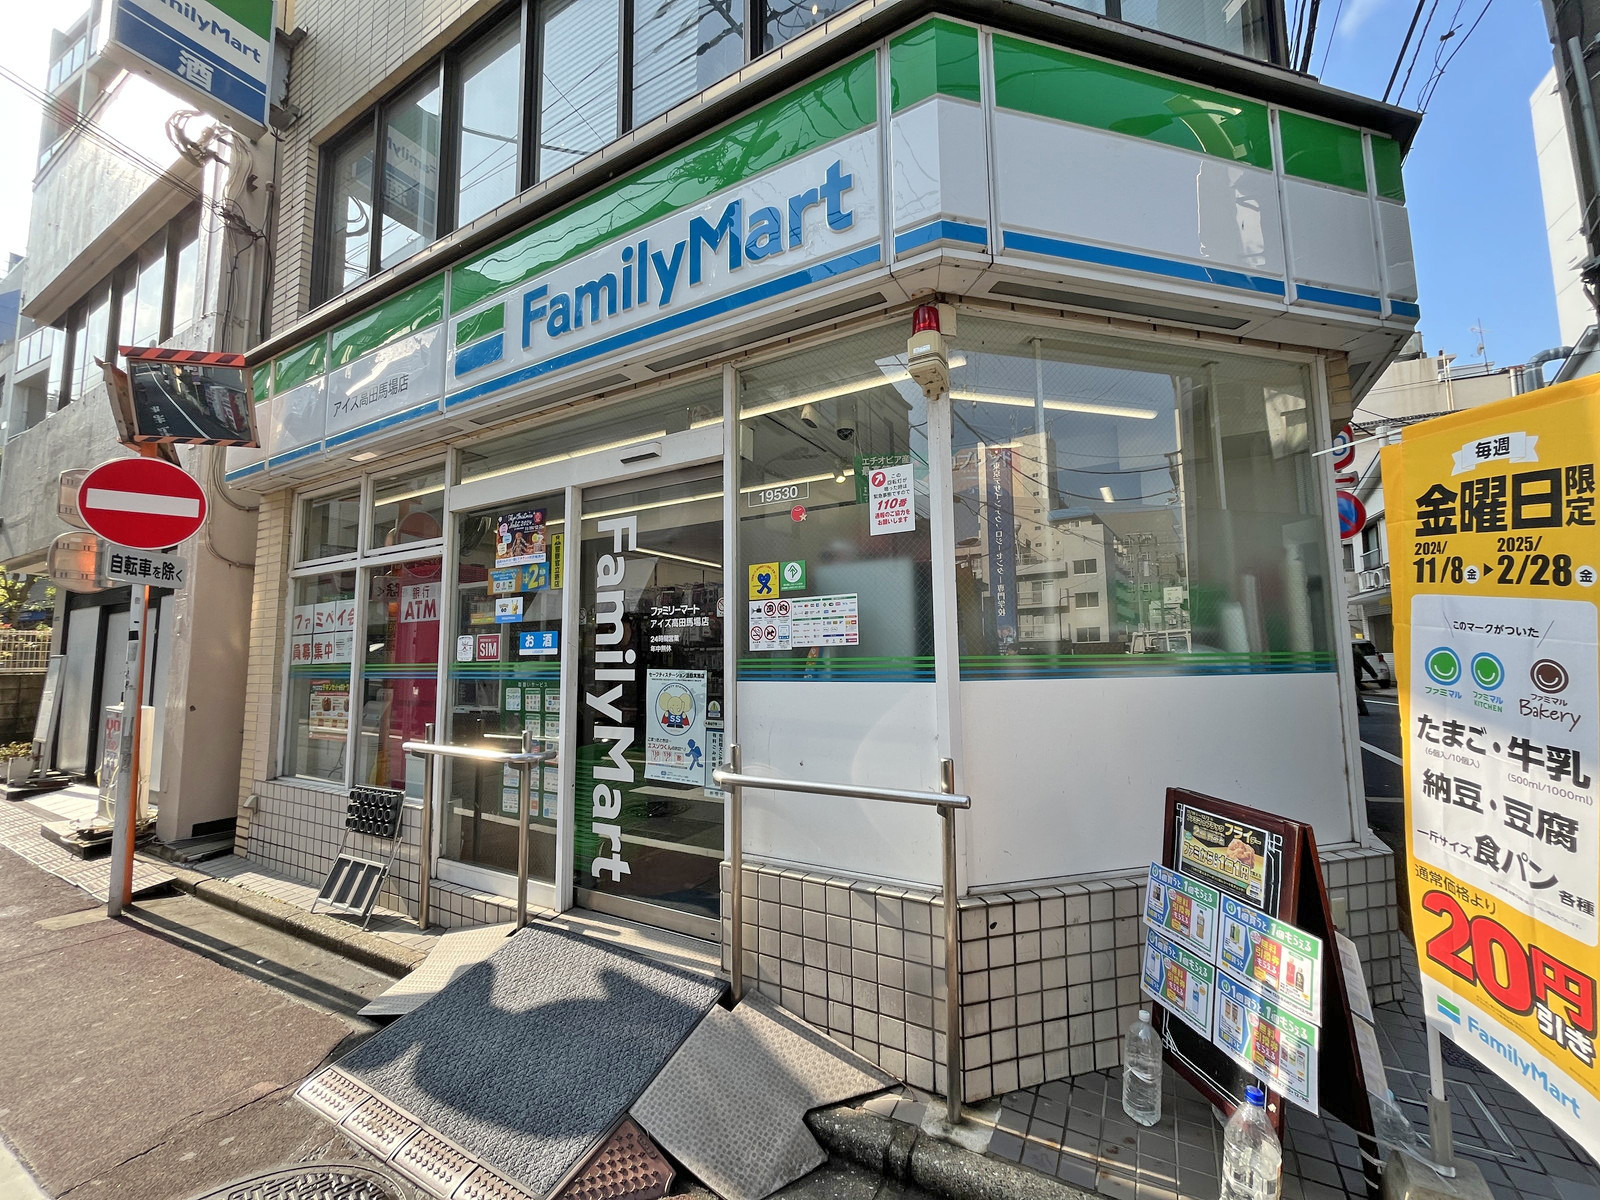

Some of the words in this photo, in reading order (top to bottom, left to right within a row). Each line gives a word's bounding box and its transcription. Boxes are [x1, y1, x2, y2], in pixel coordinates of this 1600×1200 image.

[177, 50, 214, 92] 酒
[521, 159, 856, 351] FamilyMart
[1475, 436, 1510, 459] 毎週
[758, 486, 799, 503] 19530
[877, 498, 908, 511] 110番
[1415, 467, 1563, 537] 金曜日
[1565, 463, 1596, 527] 限定
[877, 516, 909, 526] お願いします
[1414, 541, 1448, 556] 2024/
[1497, 536, 1543, 553] 2025/
[110, 553, 184, 583] 自転車を除く
[1413, 556, 1464, 584] 11/8
[1497, 554, 1572, 587] 2/28
[404, 598, 437, 621] ATM
[650, 604, 701, 617] ファミリーマート
[524, 633, 553, 648] お酒
[1453, 620, 1540, 638] このマークがついた
[292, 641, 333, 661] 員募集中
[480, 642, 497, 657] SIM
[586, 515, 638, 883] FamilyMart
[1424, 686, 1462, 699] ファミマル
[1472, 691, 1504, 705] ファミマル
[1530, 693, 1568, 707] ファミマル
[1474, 700, 1503, 713] KITCHEN
[1519, 698, 1581, 733] Bakery
[669, 715, 681, 723] SS
[1416, 714, 1592, 790] たまご・牛乳
[1507, 772, 1593, 807] (500ml/1000ml)
[1422, 768, 1579, 853] 納豆・豆腐
[1417, 827, 1472, 858] 一斤サイズ
[1473, 834, 1559, 890] 食パン
[1559, 889, 1595, 918] 各種
[1415, 863, 1497, 915] 通常価格より
[1467, 1016, 1581, 1120] FamilyMart
